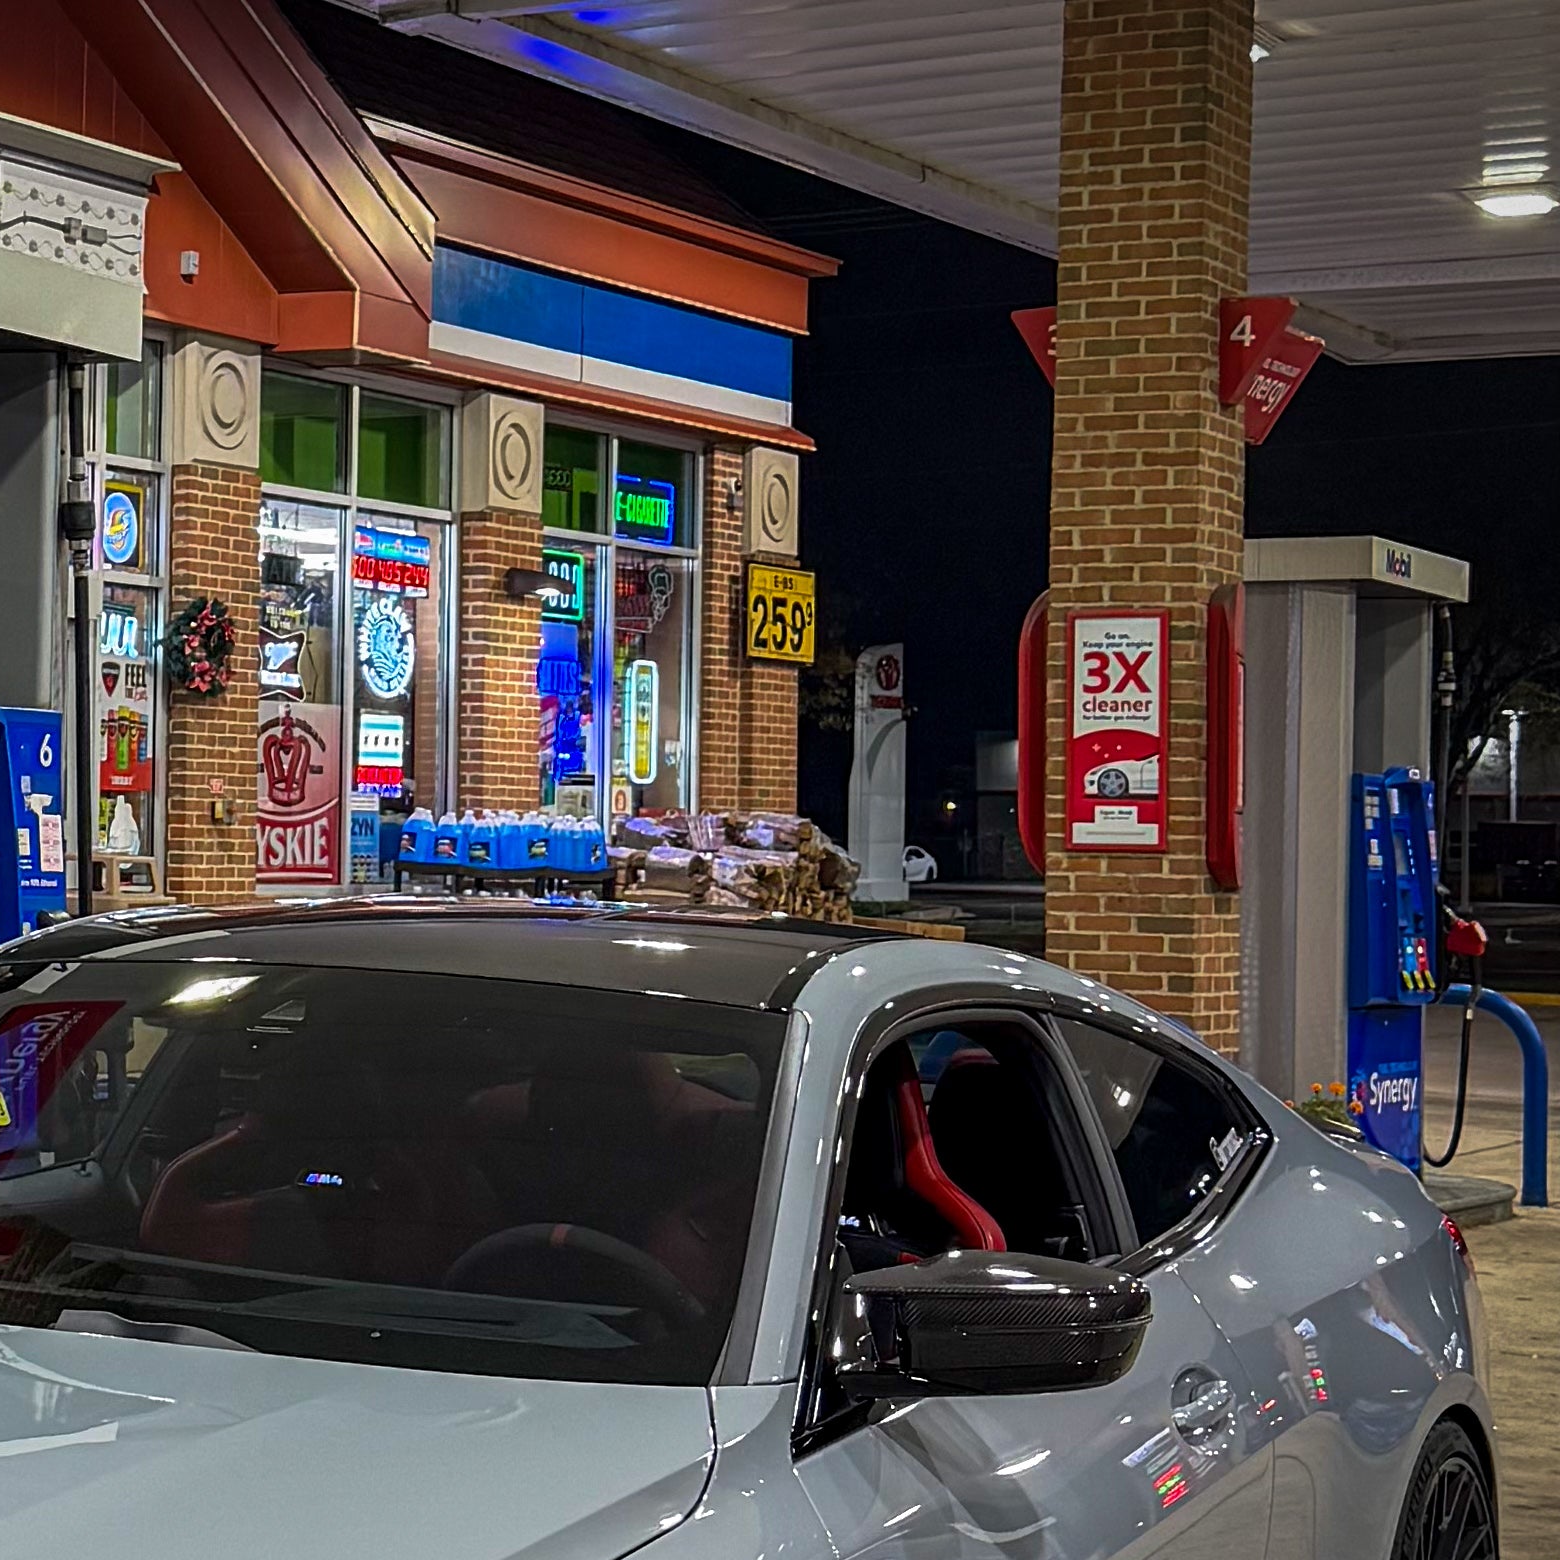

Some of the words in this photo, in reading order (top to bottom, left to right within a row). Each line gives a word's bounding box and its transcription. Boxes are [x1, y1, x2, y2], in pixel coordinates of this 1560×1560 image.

[1230, 315, 1256, 347] 4
[1385, 548, 1412, 579] Mobil
[1082, 651, 1153, 694] 3X
[1082, 695, 1153, 713] cleaner
[40, 733, 53, 767] 6
[256, 817, 329, 868] YSKIE
[351, 816, 375, 837] ZYN
[1369, 1071, 1418, 1115] Synergy
